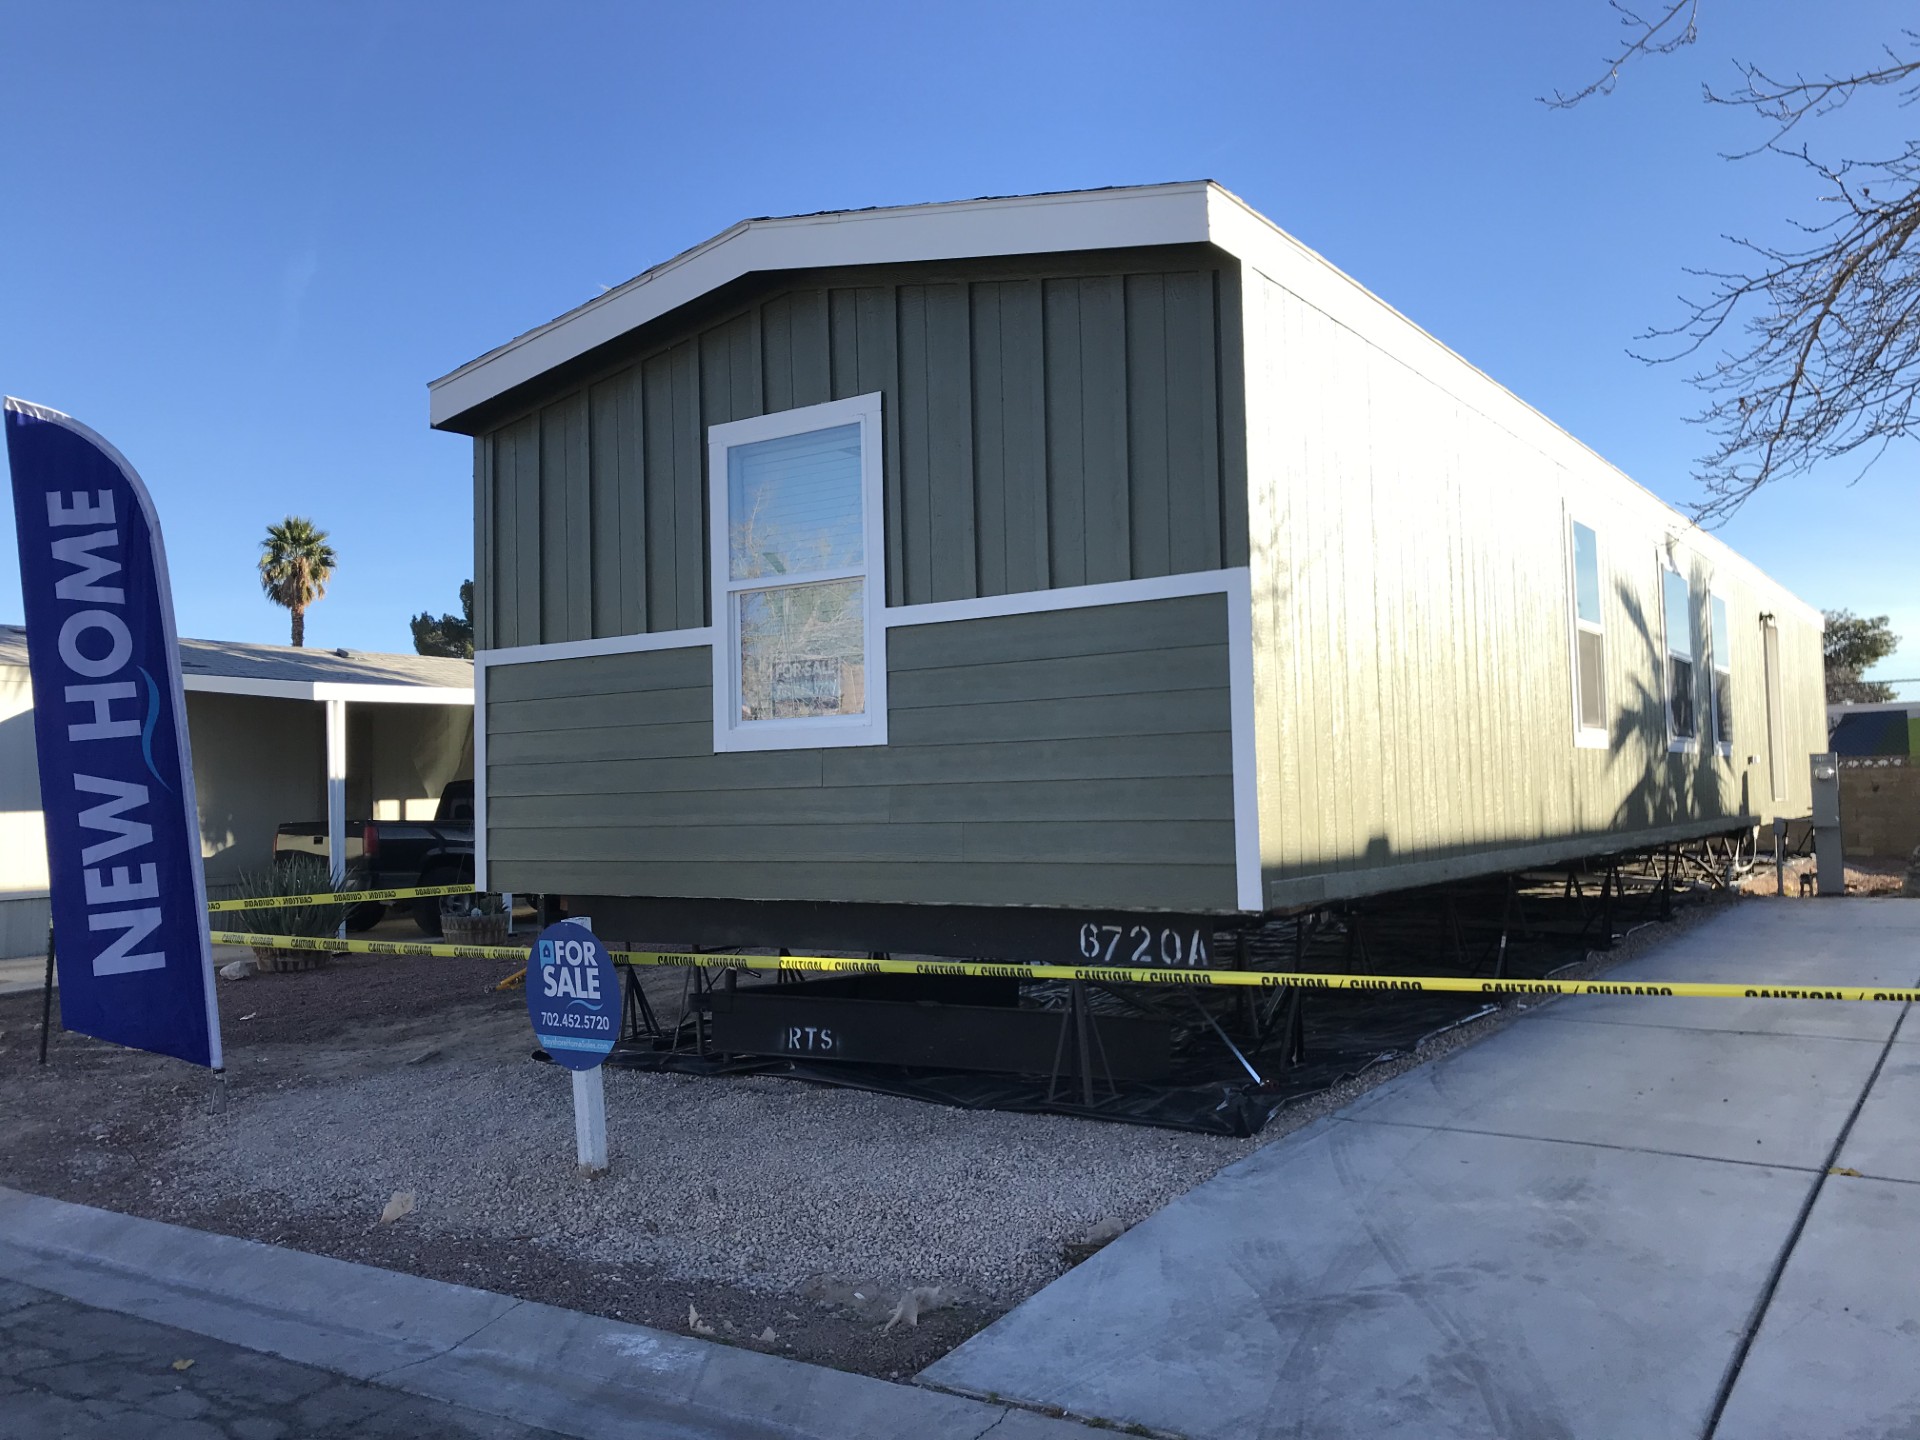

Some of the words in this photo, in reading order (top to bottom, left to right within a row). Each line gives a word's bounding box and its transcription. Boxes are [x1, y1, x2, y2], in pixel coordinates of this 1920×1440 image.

[46, 489, 141, 742] HOME
[74, 774, 166, 977] NEW
[555, 940, 598, 967] FOR
[543, 966, 600, 999] SALE
[541, 1012, 609, 1030] 702.452.5720
[789, 1027, 833, 1050] RTS
